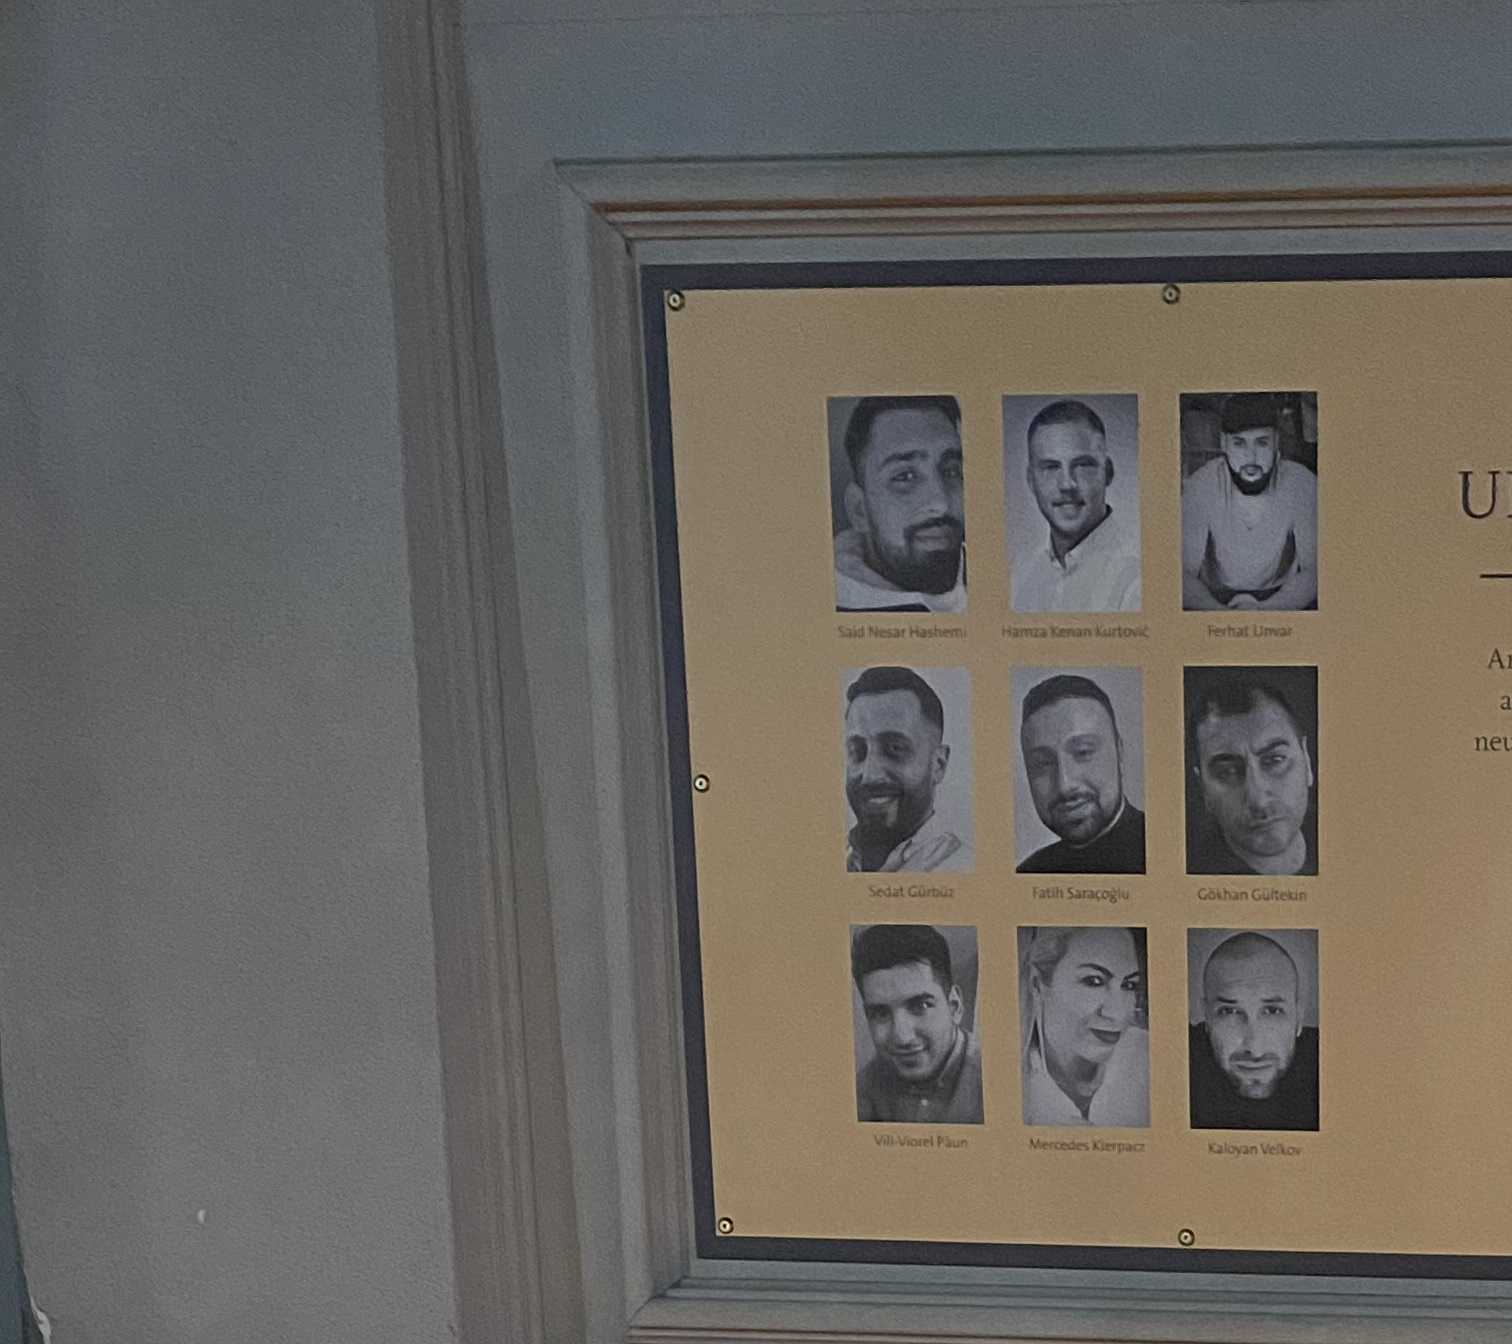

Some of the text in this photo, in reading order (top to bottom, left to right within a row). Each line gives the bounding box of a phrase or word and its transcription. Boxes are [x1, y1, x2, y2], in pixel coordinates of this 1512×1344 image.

[1206, 624, 1293, 638] Ferhat Unvar
[868, 884, 955, 899] Sedat Gürbüz
[1196, 887, 1308, 902] Gökhan Gültekin
[1028, 1137, 1146, 1155] Mercedes Kierpacz
[1207, 1142, 1302, 1158] Kaloyan Velkov
